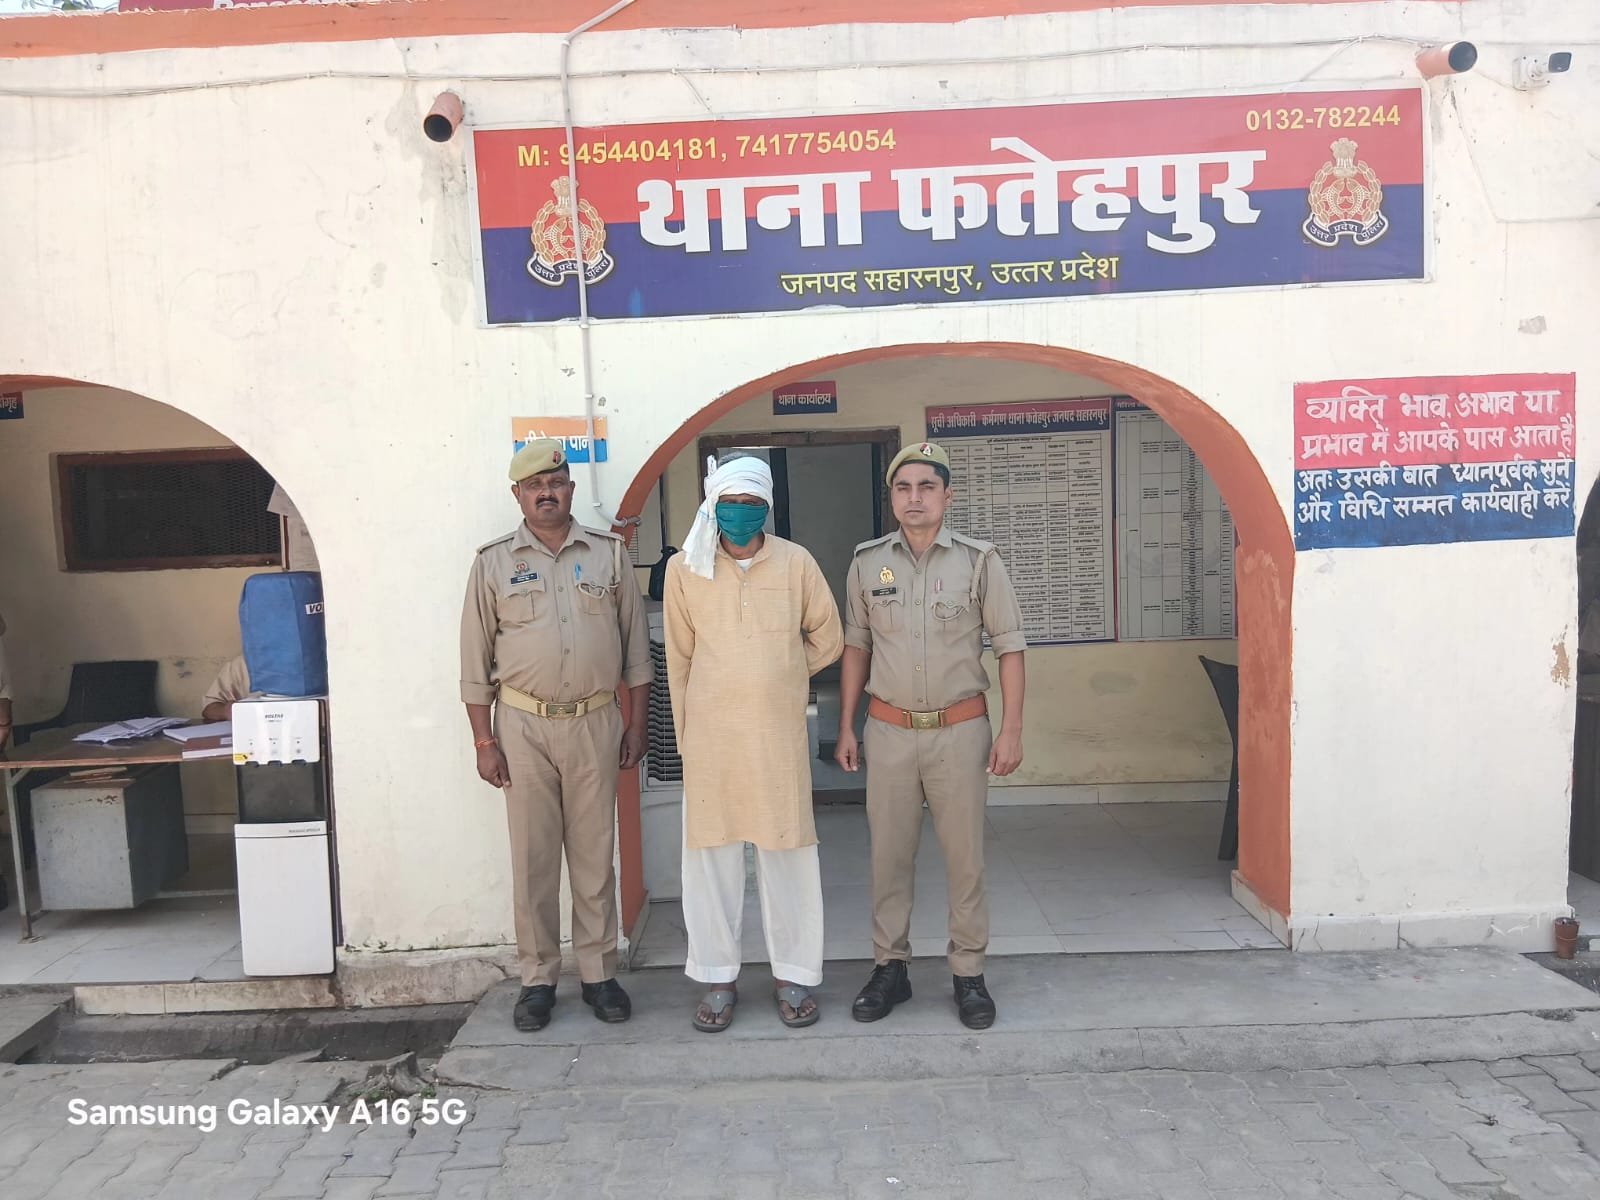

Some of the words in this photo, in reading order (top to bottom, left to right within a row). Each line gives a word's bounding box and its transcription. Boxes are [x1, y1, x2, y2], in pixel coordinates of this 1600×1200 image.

[1245, 104, 1401, 132] 0132-782244
[517, 144, 551, 168] M:
[735, 129, 897, 159] 7417754054
[637, 171, 872, 254] थाना
[890, 137, 1267, 255] फतेहपुर
[781, 270, 857, 296] जनपद
[864, 264, 982, 295] सहारनपुर,
[991, 257, 1054, 285] उत्तर
[1061, 252, 1119, 280] प्रदेश
[778, 393, 796, 407] थाना
[797, 388, 832, 406] कार्यालय
[1305, 385, 1388, 423] व्यक्ति
[1454, 391, 1519, 418] अभाव
[1521, 390, 1562, 415] या
[1301, 432, 1369, 460] प्रभाव
[1371, 424, 1391, 455] में
[1393, 421, 1460, 453] आपके
[1463, 426, 1508, 451] पास
[1510, 425, 1561, 449] आता
[1560, 413, 1575, 453] है
[1297, 469, 1333, 492] अतः
[1336, 460, 1400, 490] उसकी
[1403, 464, 1443, 488] बात
[1540, 451, 1575, 486] सुनें
[1297, 491, 1334, 524] और
[1338, 490, 1391, 520] विधि
[1392, 494, 1458, 519] सम्मत
[1461, 482, 1541, 519] कार्यवाही
[1542, 480, 1572, 510] करें
[309, 602, 323, 614] VO
